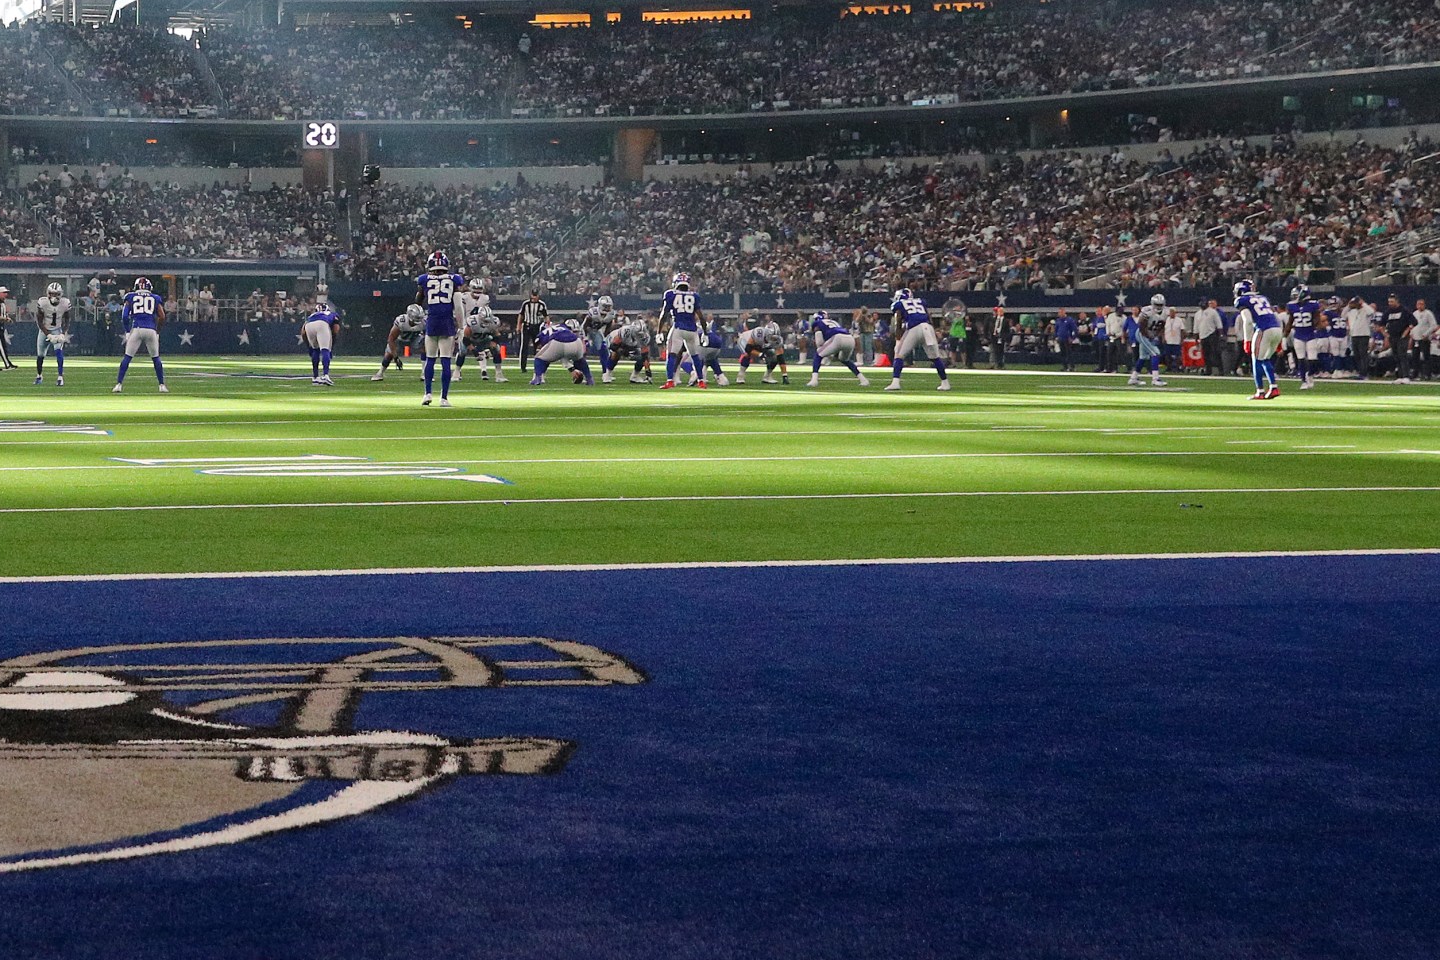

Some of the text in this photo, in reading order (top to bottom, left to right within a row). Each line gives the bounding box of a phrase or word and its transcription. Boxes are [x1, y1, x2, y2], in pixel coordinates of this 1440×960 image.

[306, 122, 336, 146] 20
[426, 280, 454, 305] 29
[132, 295, 155, 315] 20
[672, 294, 696, 314] 48
[903, 298, 927, 314] 55
[50, 312, 58, 327] 1
[1293, 312, 1312, 328] 22
[1188, 345, 1202, 360] G
